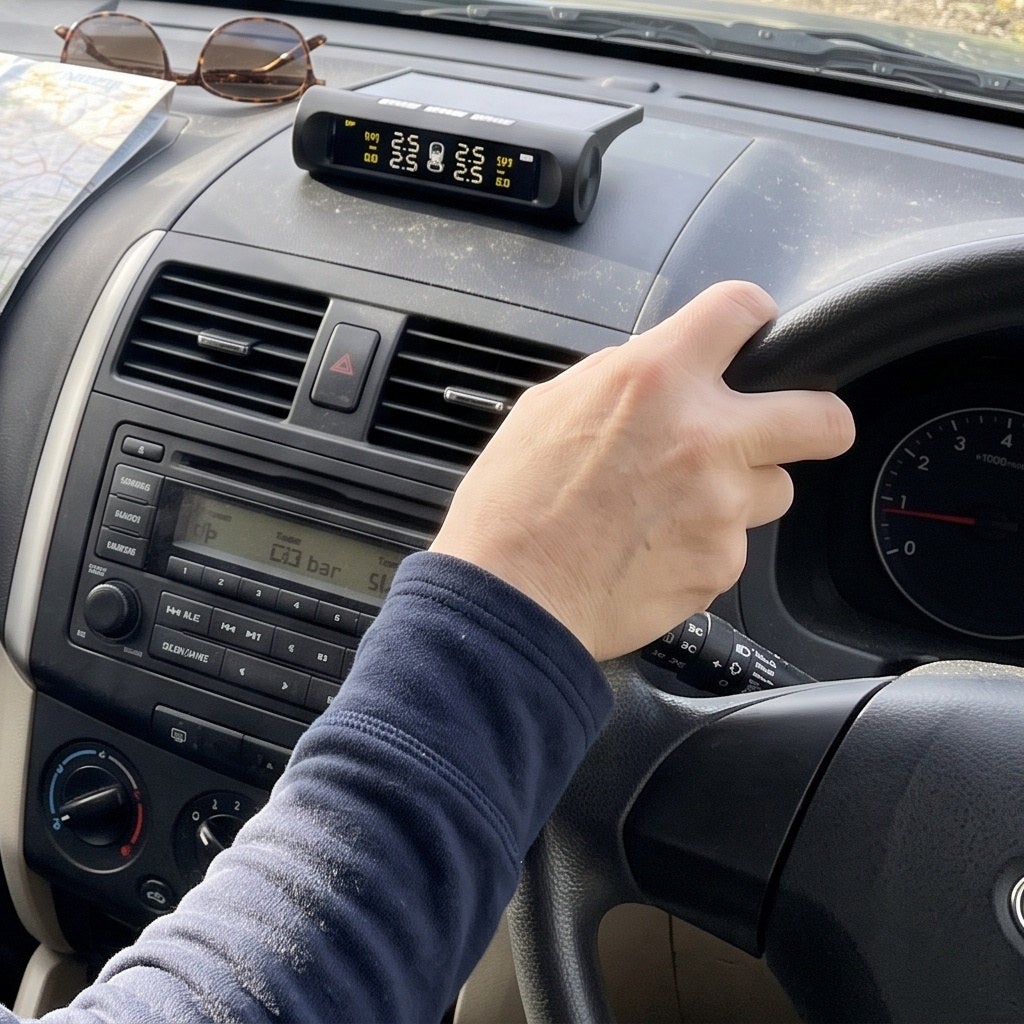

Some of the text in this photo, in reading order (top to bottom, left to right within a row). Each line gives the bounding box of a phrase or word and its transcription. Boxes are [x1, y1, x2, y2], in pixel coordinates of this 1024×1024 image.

[391, 131, 420, 153] 2.5
[389, 150, 418, 172] 2.5
[454, 142, 485, 165] 2.5
[453, 162, 483, 184] 2.5
[954, 436, 966, 451] 3
[1001, 434, 1013, 449] 4
[918, 455, 930, 471] 2
[900, 494, 907, 510] 1
[904, 540, 916, 556] 0
[306, 555, 341, 578] bar
